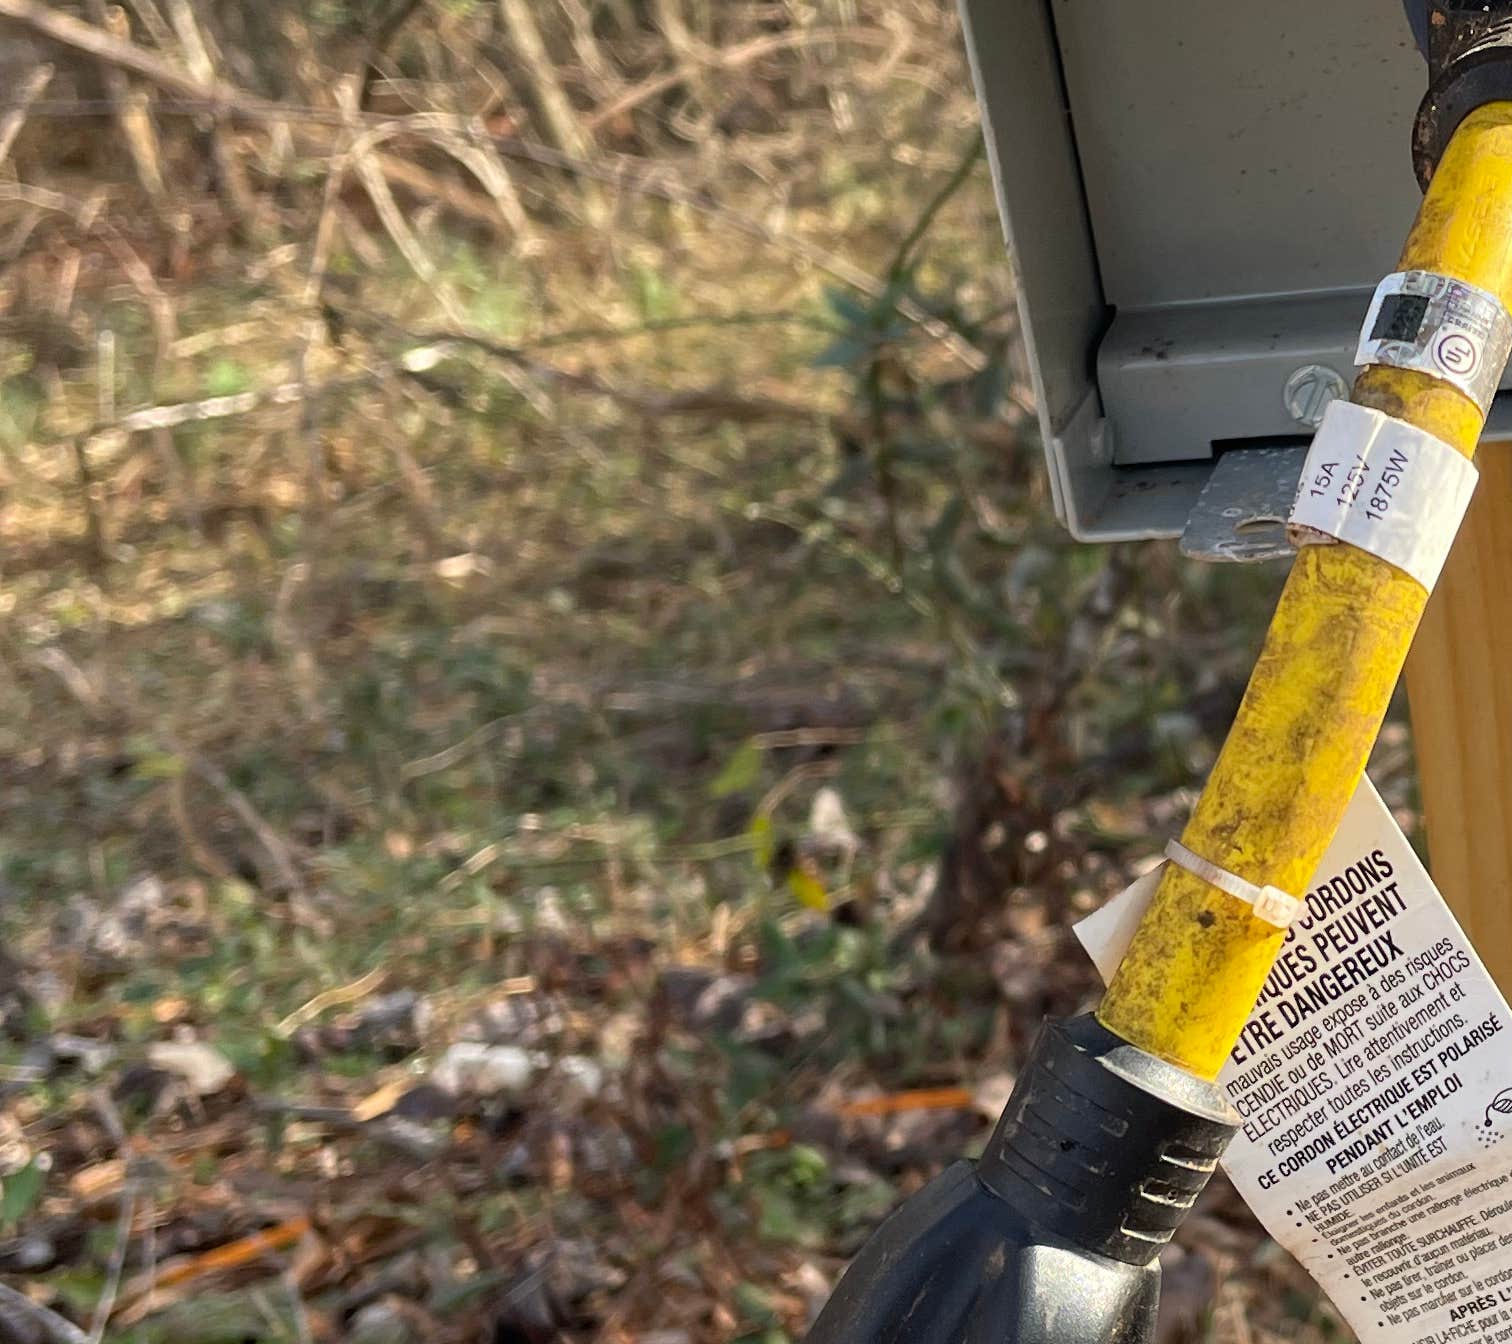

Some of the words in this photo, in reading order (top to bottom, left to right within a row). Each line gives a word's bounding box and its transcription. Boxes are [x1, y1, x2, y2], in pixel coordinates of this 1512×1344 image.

[1308, 455, 1340, 501] 15A
[1334, 453, 1372, 511] 125V
[1364, 448, 1411, 526] 1875W
[1310, 881, 1411, 963] PEUVENT
[1223, 1049, 1283, 1098] mauvais
[1279, 1023, 1326, 1064] usage
[1320, 992, 1373, 1038] expose
[1365, 982, 1381, 1001] à
[1376, 964, 1407, 994] des
[1402, 934, 1457, 978] risques
[1276, 929, 1405, 1029] DANGEREUX
[1231, 1073, 1289, 1121] CENDIE
[1286, 1064, 1308, 1085] ou
[1303, 1048, 1327, 1072] de
[1322, 1020, 1367, 1059] MORT
[1362, 997, 1400, 1032] suite
[1397, 984, 1425, 1009] aux
[1420, 949, 1471, 992] CHOCS
[1333, 1050, 1364, 1080] Lire
[1360, 991, 1451, 1062] attentivement
[1446, 981, 1467, 1003] et
[1256, 1168, 1280, 1191] CE
[1275, 1129, 1336, 1178] CORDON
[1330, 1074, 1415, 1140] ÉLECTRIQUE
[1410, 1058, 1440, 1086] EST
[1436, 1013, 1503, 1069] POLARISÉ
[1265, 1104, 1333, 1159] respecter
[1326, 1075, 1372, 1114] toutes
[1366, 1060, 1392, 1085] les
[1387, 1008, 1469, 1072] instructions.
[1325, 1118, 1397, 1176] PENDANT
[1393, 1072, 1464, 1128] L'EMPLOI
[1294, 1197, 1311, 1213] Ne
[1310, 1188, 1331, 1206] pas
[1328, 1168, 1361, 1194] mettre
[1359, 1163, 1375, 1178] au
[1371, 1141, 1408, 1170] contact
[1404, 1131, 1421, 1149] de
[1304, 1209, 1322, 1225] NE
[1319, 1197, 1342, 1218] PAS
[1339, 1175, 1382, 1207] UTILISER
[1380, 1168, 1395, 1184] SI
[1426, 1135, 1449, 1159] EST
[1336, 1242, 1353, 1257] Ne
[1352, 1235, 1372, 1252] pas
[1407, 1210, 1426, 1226] une
[1369, 1286, 1386, 1302] Ne
[1384, 1280, 1404, 1298] pas
[1454, 1251, 1470, 1265] ou
[1467, 1237, 1499, 1261] placer
[1385, 1240, 1417, 1263] TOUTE
[1386, 1311, 1403, 1327] Ne
[1401, 1305, 1421, 1323] pas
[1457, 1284, 1474, 1298] sur
[1472, 1278, 1484, 1292] le
[1447, 1290, 1497, 1322] APRÈS
[1477, 1312, 1500, 1332] pour
[1498, 1307, 1511, 1322] la
